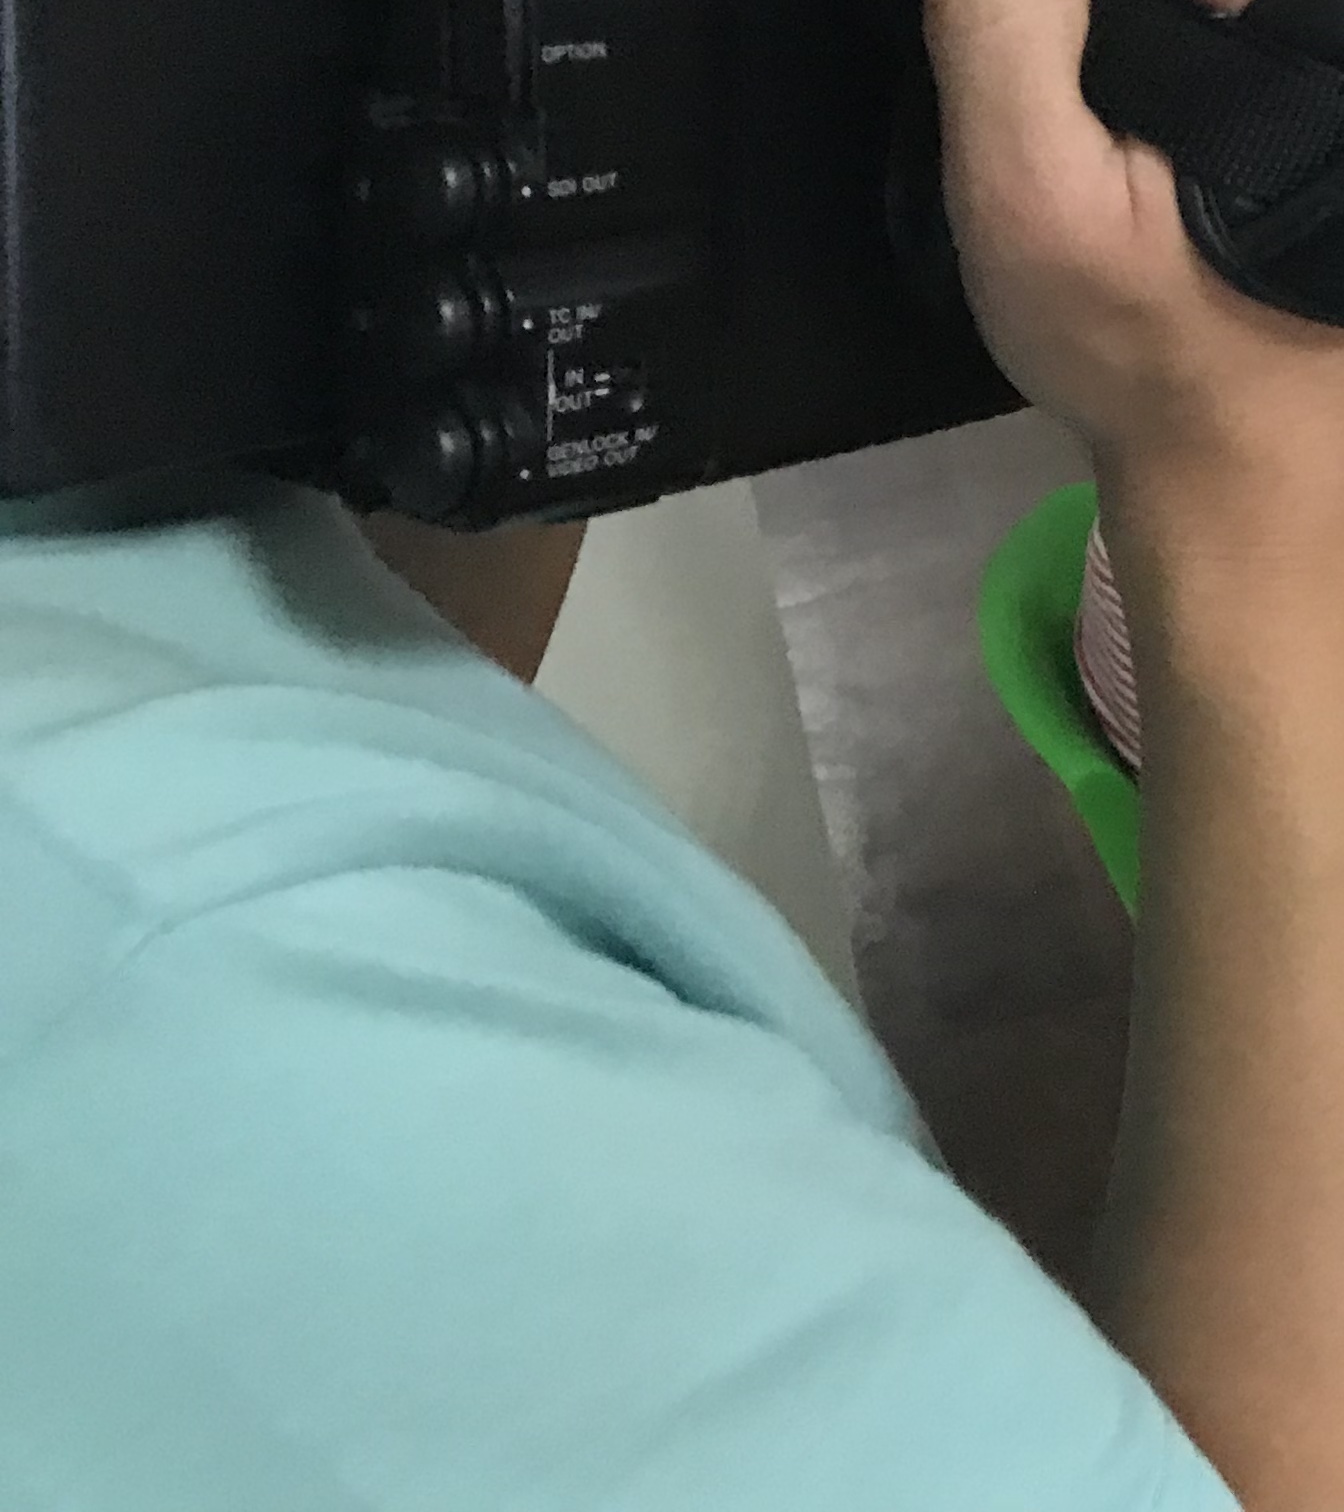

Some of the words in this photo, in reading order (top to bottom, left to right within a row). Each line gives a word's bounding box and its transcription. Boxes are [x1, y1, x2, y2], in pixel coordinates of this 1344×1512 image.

[540, 41, 607, 65] OPTION
[581, 172, 619, 193] OUT
[547, 324, 585, 344] OUT
[555, 390, 593, 413] OUT
